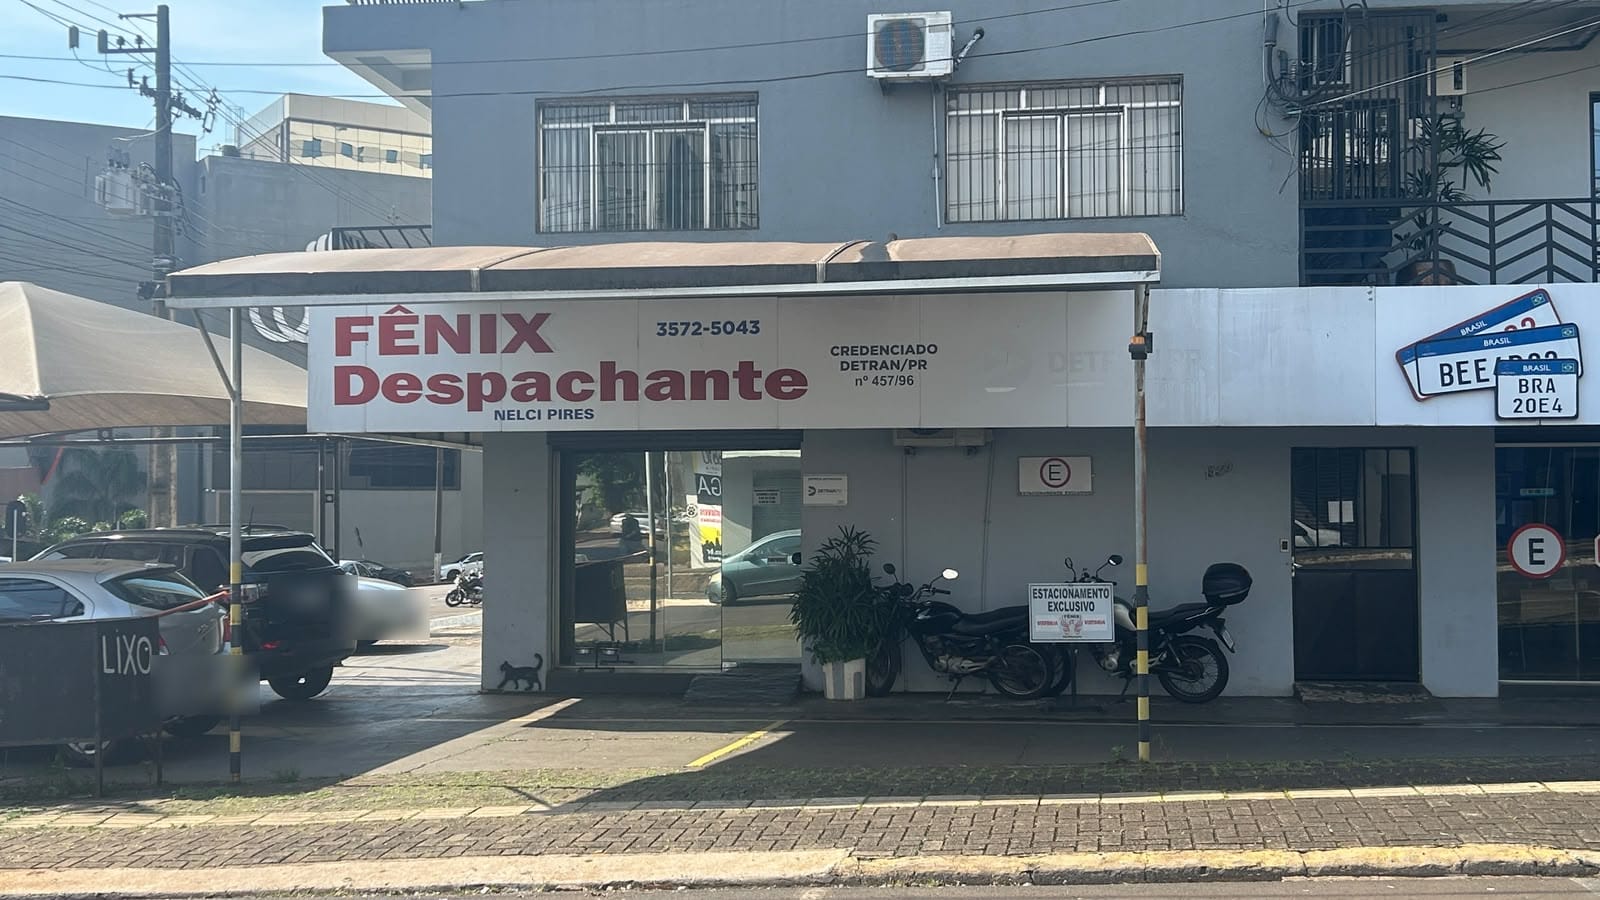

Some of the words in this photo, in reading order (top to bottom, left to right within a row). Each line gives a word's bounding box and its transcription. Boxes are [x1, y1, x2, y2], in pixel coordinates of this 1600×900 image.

[334, 304, 554, 357] FÊNIX
[656, 320, 760, 336] 3572-5043
[1460, 320, 1488, 336] BRASIL
[1483, 337, 1512, 347] BRASIL
[830, 344, 938, 357] CREDENCIADO
[840, 359, 928, 372] DETRAN/PR
[1522, 364, 1551, 372] BRASIL
[334, 361, 809, 412] Despachante
[871, 375, 914, 386] 457/96
[1518, 378, 1556, 394] BRA
[1513, 398, 1563, 414] 20E4
[494, 409, 542, 421] NELCI
[547, 408, 594, 420] PIRES
[1048, 464, 1062, 481] E
[1528, 538, 1545, 565] E
[1032, 588, 1110, 599] ESTACIONAMENTO
[1047, 601, 1095, 612] EXCLUSIVO
[102, 631, 152, 675] LIXO
